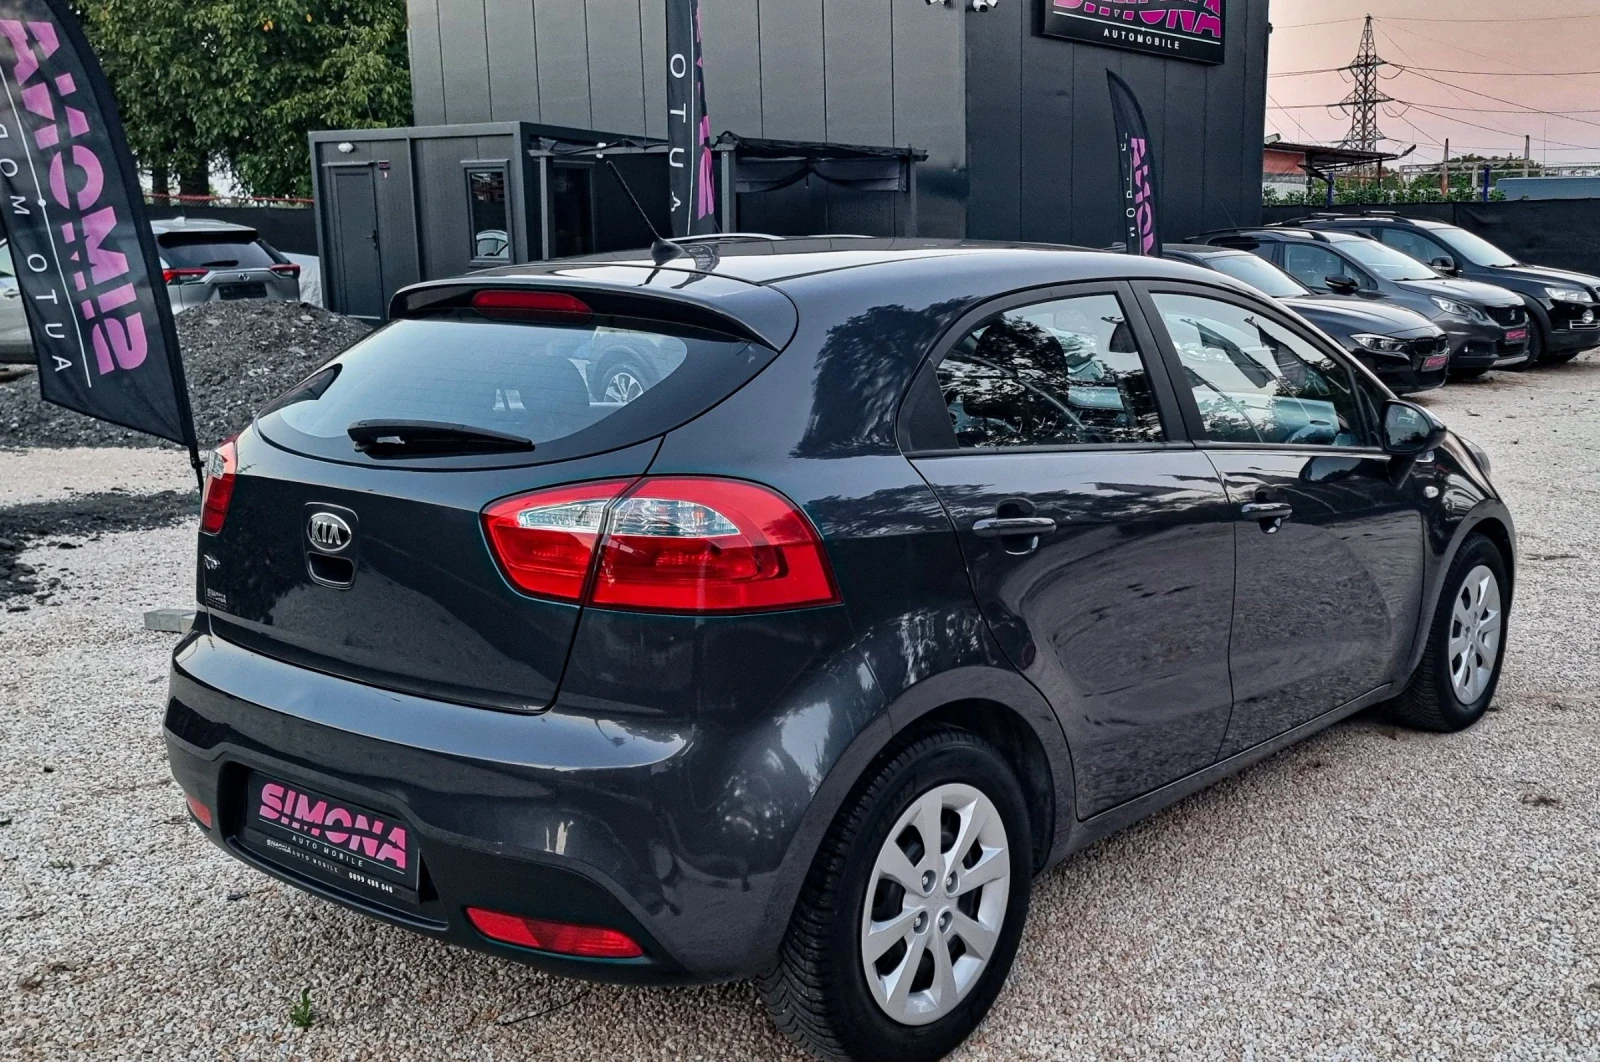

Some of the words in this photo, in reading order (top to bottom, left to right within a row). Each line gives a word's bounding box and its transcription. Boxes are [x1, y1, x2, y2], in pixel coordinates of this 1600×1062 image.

[1103, 28, 1180, 50] AUTOMOBILE
[311, 519, 342, 546] KIA
[259, 783, 406, 869] SIMONA
[292, 835, 318, 850] AUTO
[323, 846, 364, 868] MOBILE
